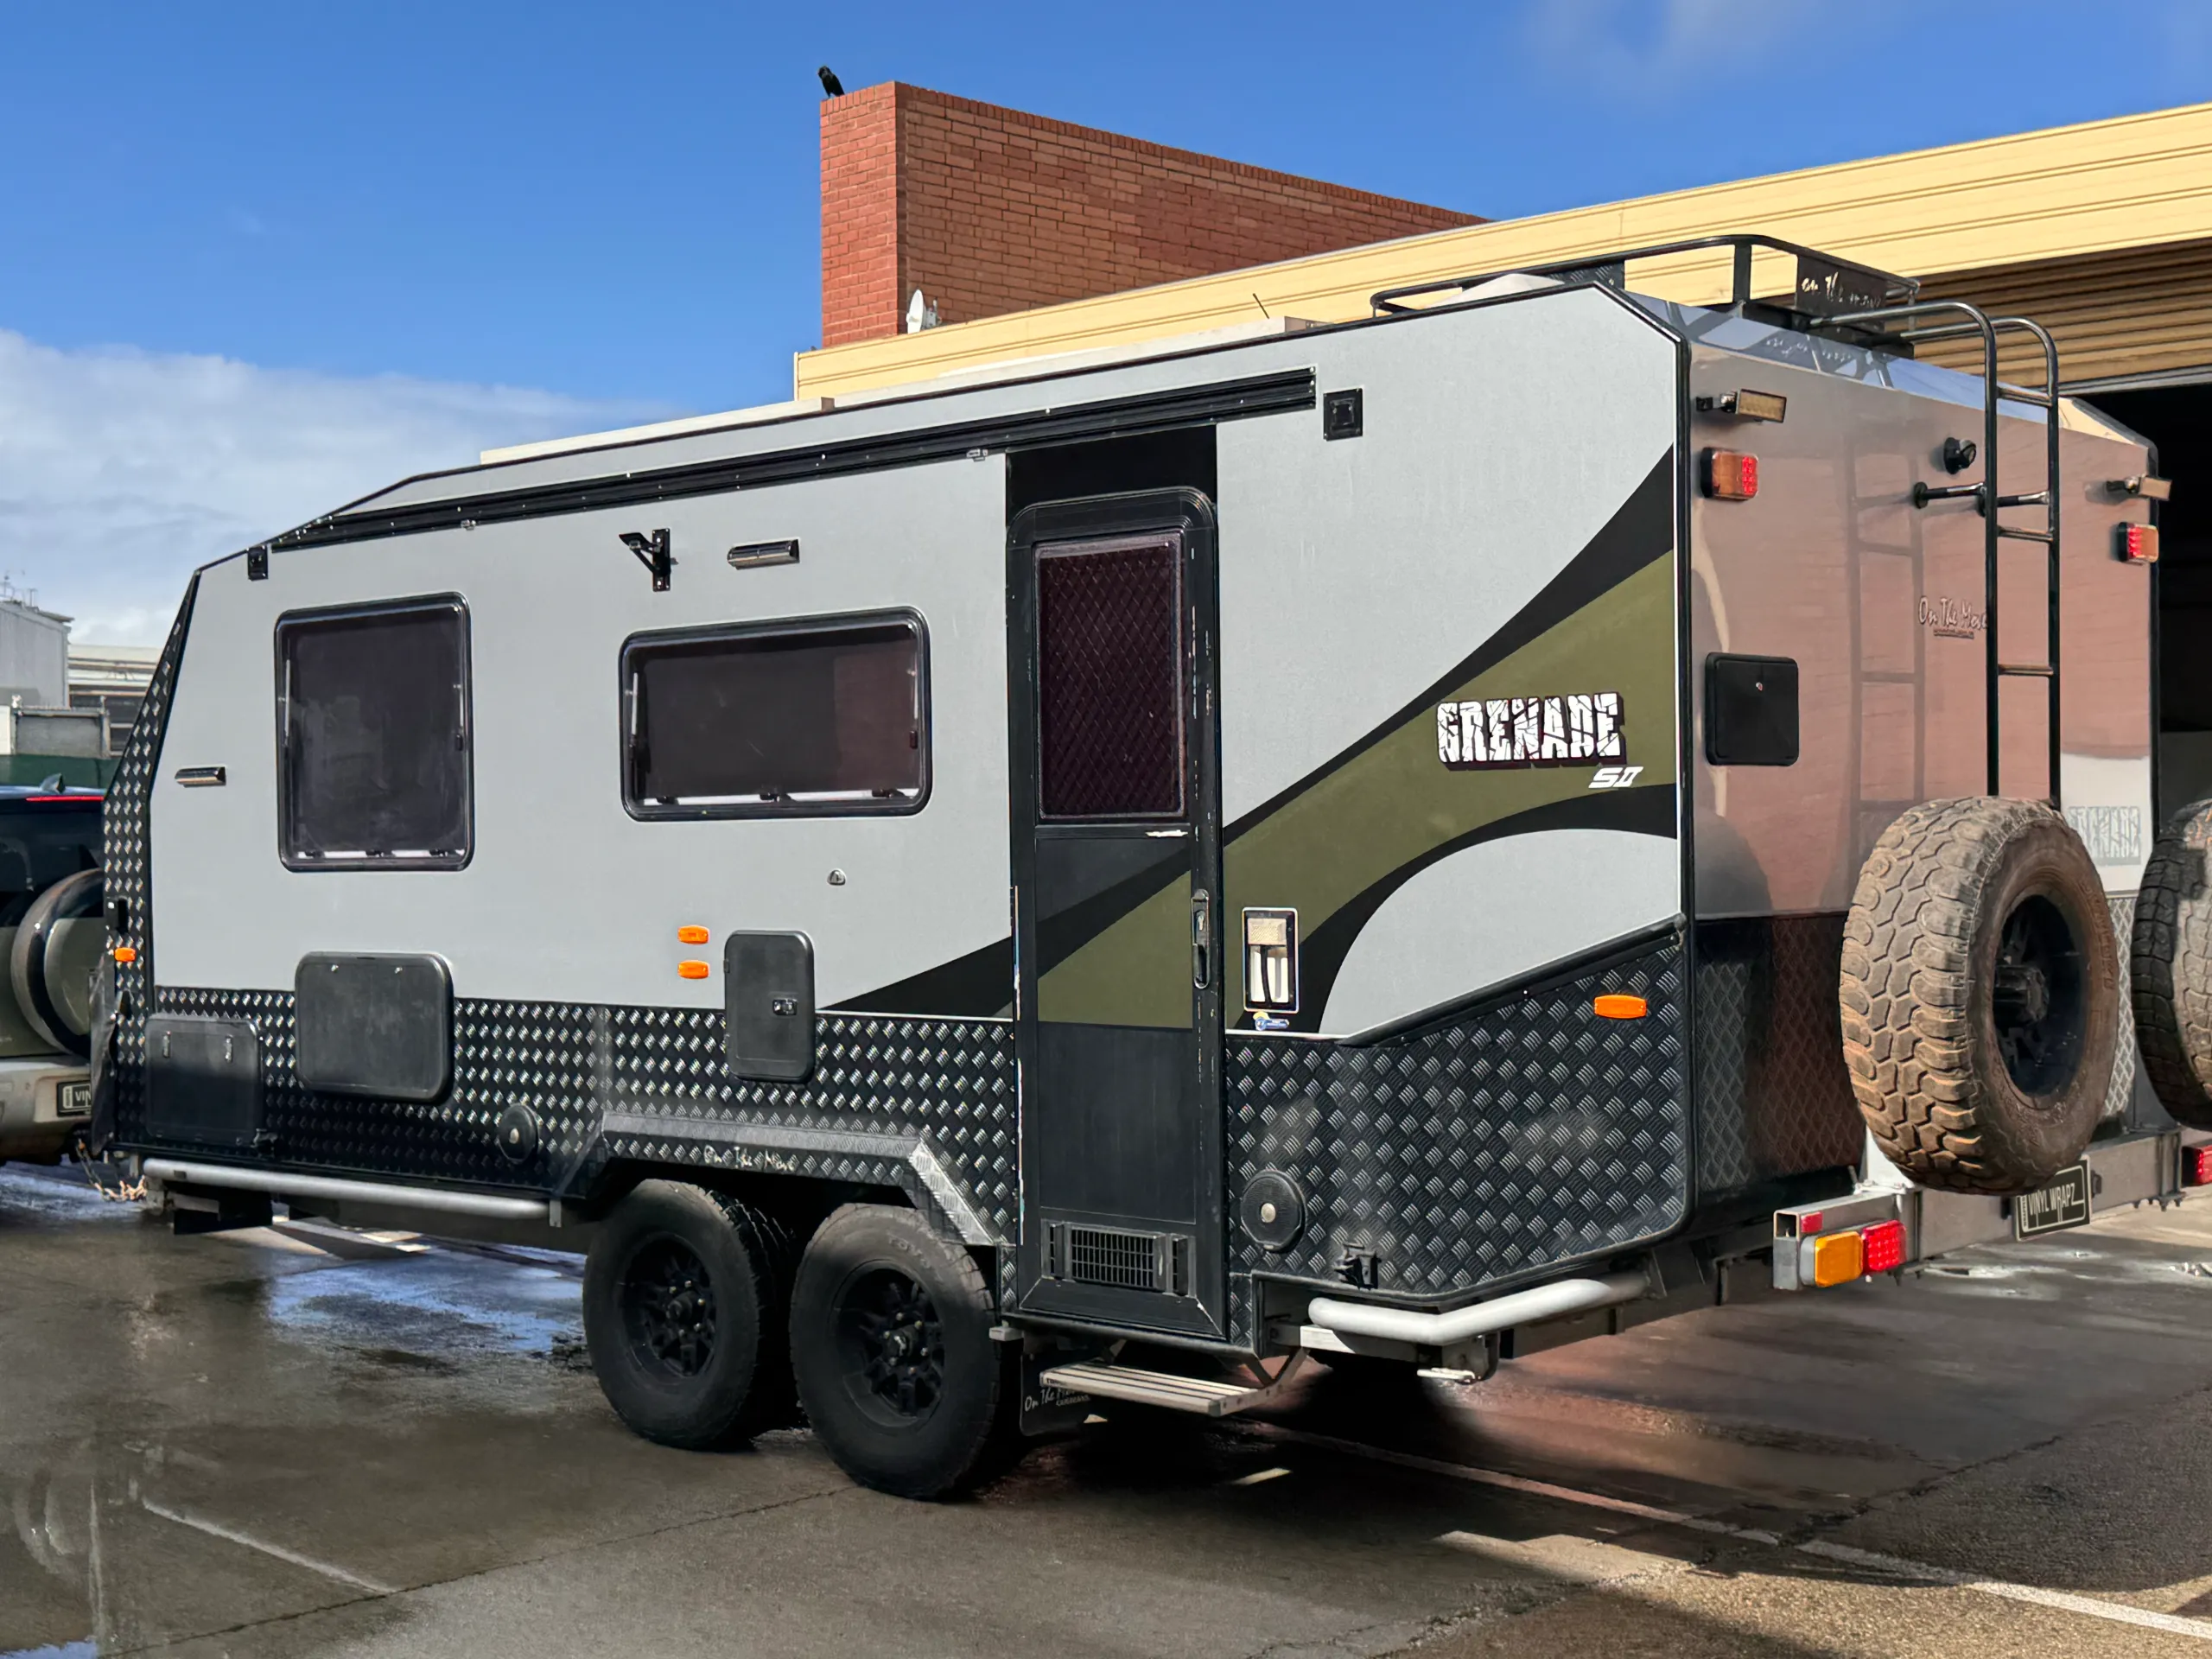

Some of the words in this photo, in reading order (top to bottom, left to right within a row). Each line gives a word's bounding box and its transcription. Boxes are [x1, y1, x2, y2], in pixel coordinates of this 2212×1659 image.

[1437, 692, 1626, 771] GRENADE
[2028, 1189, 2049, 1216] VINYL
[2049, 1182, 2075, 1211] WRAPZ
